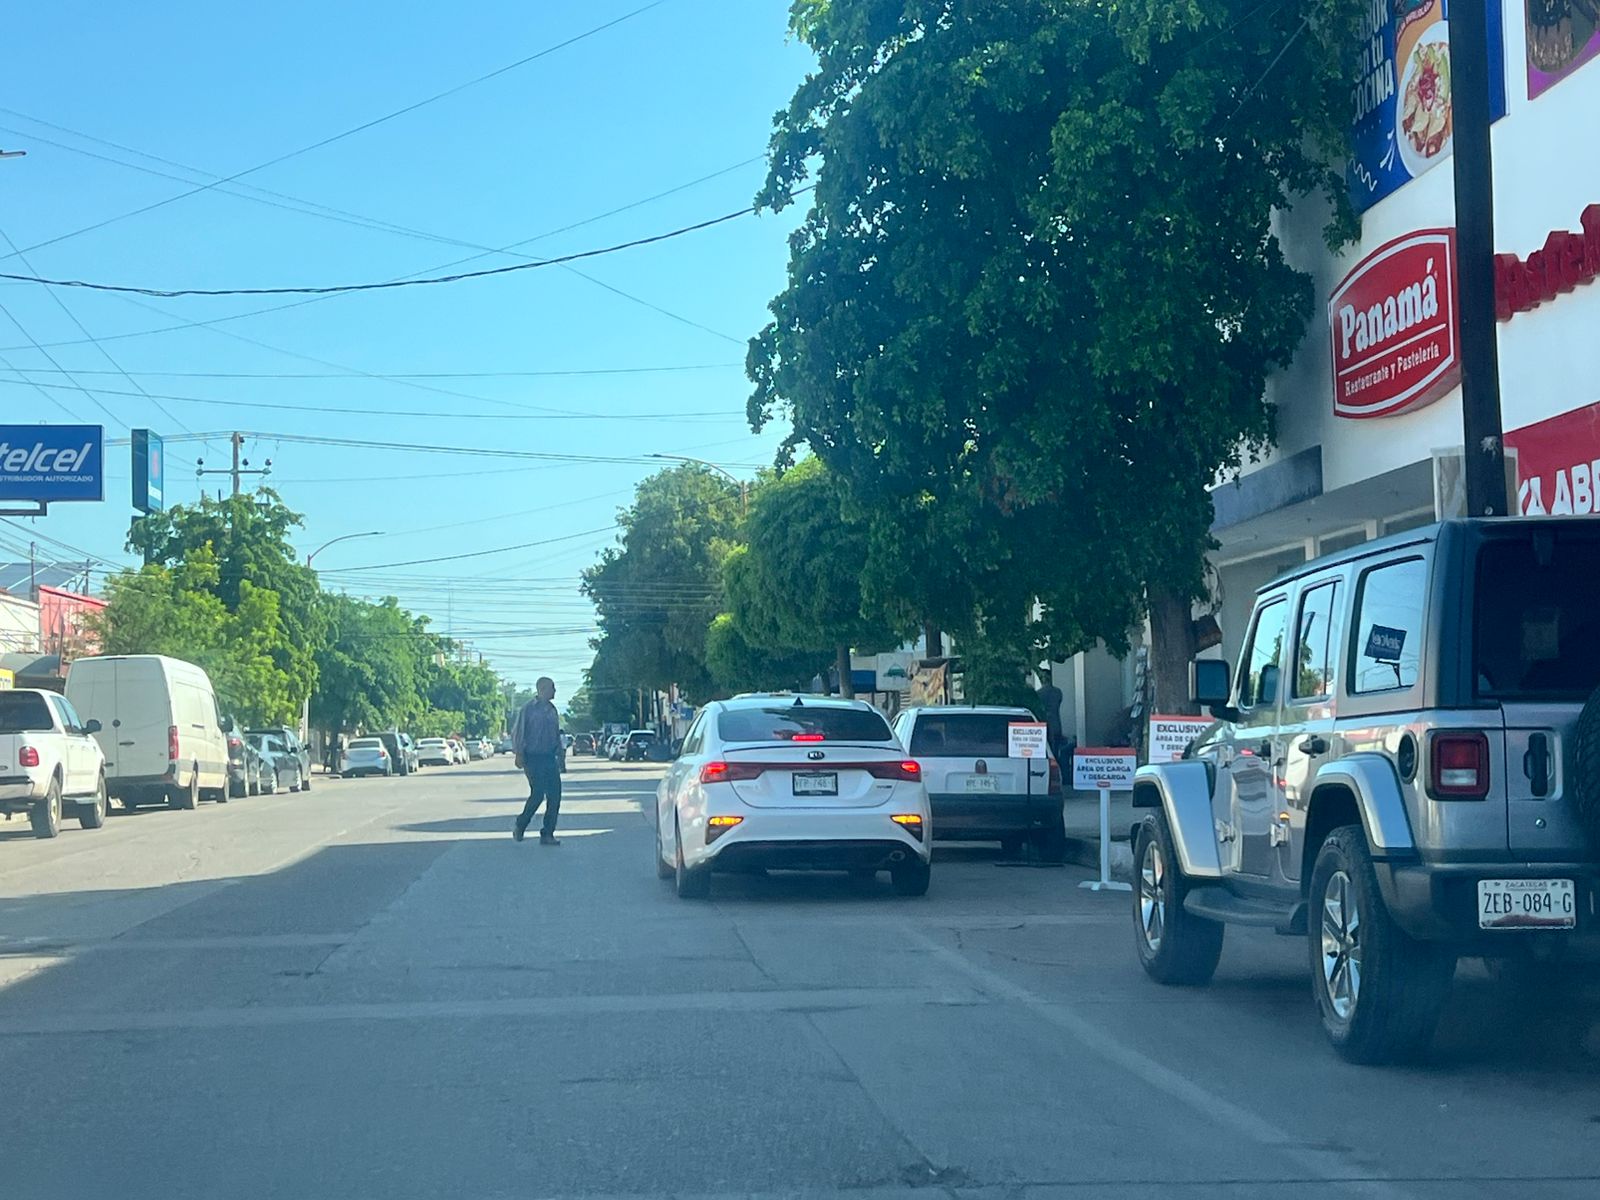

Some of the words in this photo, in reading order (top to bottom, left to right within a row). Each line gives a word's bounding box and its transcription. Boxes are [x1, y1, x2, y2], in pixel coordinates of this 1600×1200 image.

[1371, 34, 1384, 68] tu
[1340, 257, 1438, 359] Panamá
[1345, 362, 1389, 397] Restaurante
[1390, 363, 1396, 380] y
[1397, 341, 1440, 374] Pastelería
[0, 442, 93, 472] telcel
[1157, 724, 1207, 733] EXCLUSIVO
[1484, 892, 1572, 913] ZEB-084-G
